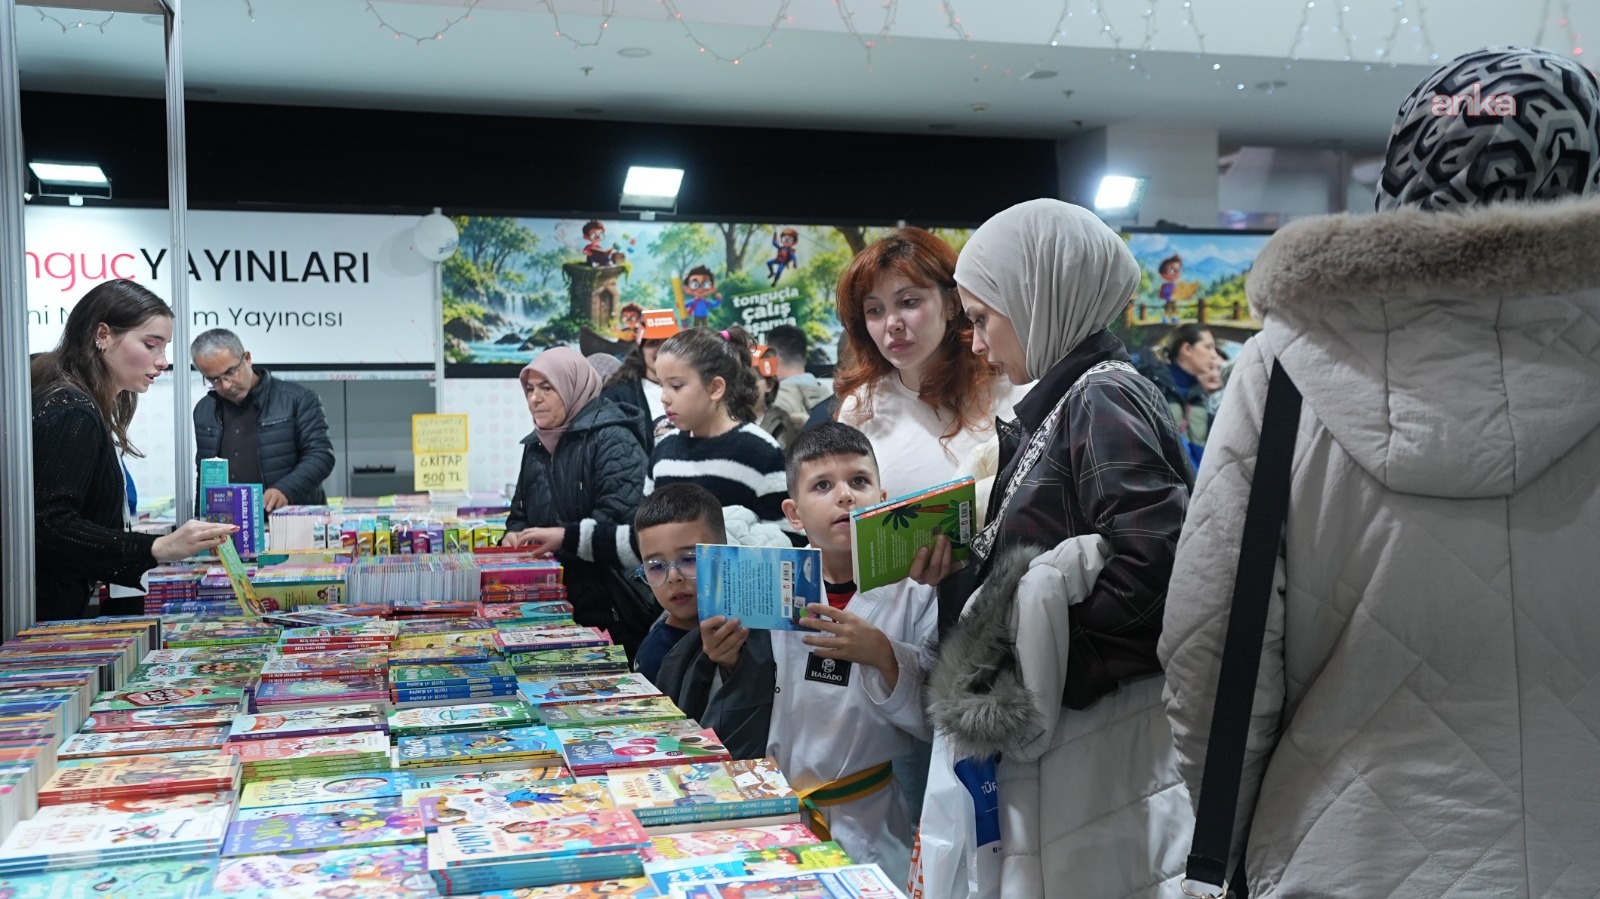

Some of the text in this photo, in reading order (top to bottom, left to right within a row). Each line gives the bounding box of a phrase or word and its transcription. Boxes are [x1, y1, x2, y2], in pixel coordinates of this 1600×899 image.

[733, 287, 799, 308] tonguçla
[228, 307, 343, 333] Yayıncısı
[742, 302, 791, 324] çalış
[420, 454, 462, 468] 6 KİTAP
[423, 472, 462, 484] 500 TL
[811, 670, 843, 681] HASADO
